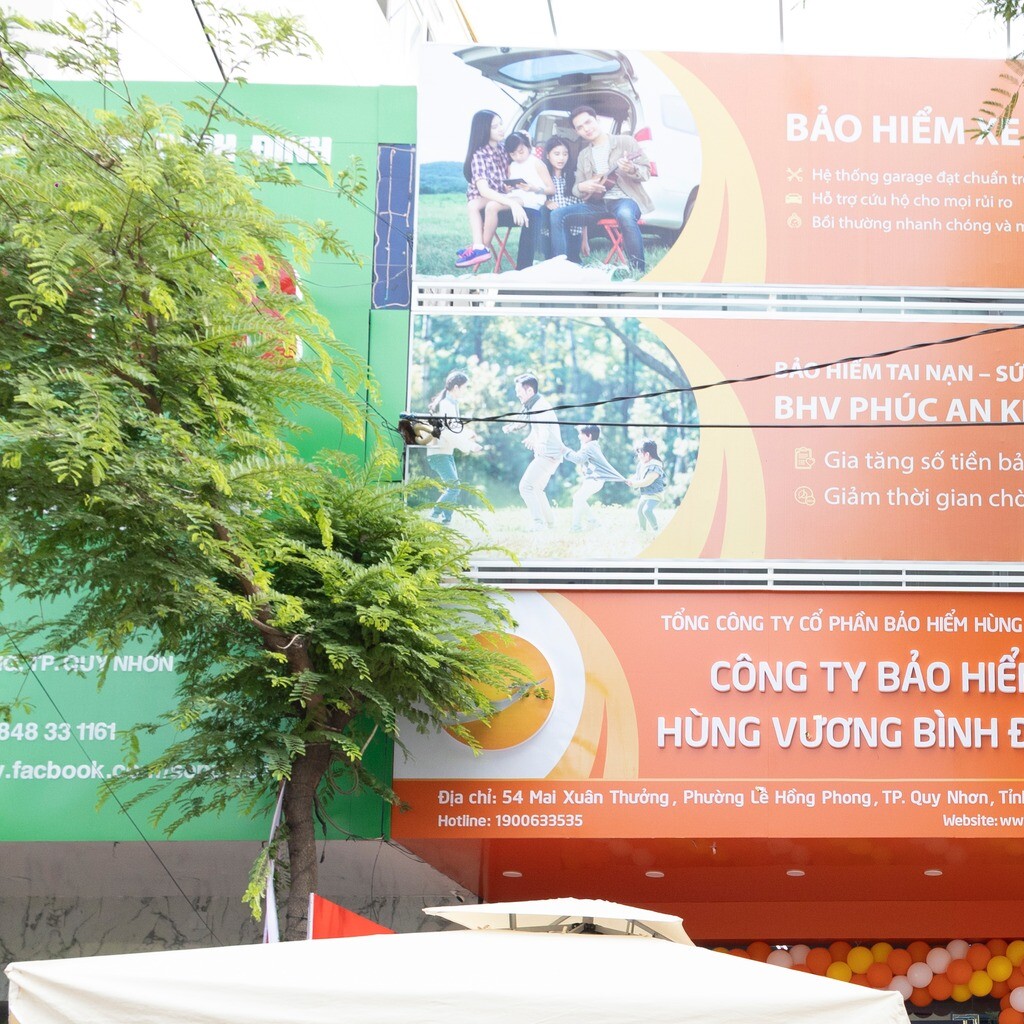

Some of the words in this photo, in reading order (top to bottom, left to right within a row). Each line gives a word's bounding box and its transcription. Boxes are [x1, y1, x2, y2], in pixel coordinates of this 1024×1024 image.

[786, 105, 862, 142] BẢO
[872, 106, 965, 145] HIỂM
[974, 117, 1020, 147] XE
[812, 168, 832, 184] Hệ
[835, 167, 879, 185] thống
[883, 172, 933, 186] garage
[936, 170, 960, 186] đạt
[963, 169, 1007, 185] chuẩn
[812, 189, 833, 206] Hỗ
[836, 194, 857, 208] trợ
[860, 191, 887, 207] cứu
[890, 192, 910, 209] hộ
[913, 194, 940, 207] cho
[944, 195, 971, 210] mọi
[975, 194, 994, 209] rủi
[998, 198, 1013, 208] ro
[811, 214, 835, 229] Bồi
[838, 215, 892, 232] thường
[896, 216, 942, 232] nhanh
[946, 218, 992, 234] chóng
[995, 219, 1012, 233] và
[775, 357, 820, 380] BẢO
[886, 363, 921, 381] TAI
[926, 363, 973, 387] NẠN
[774, 395, 842, 421] BHV
[850, 392, 938, 422] PHÚC
[945, 398, 990, 422] AN
[824, 451, 858, 470] Gia
[865, 451, 915, 475] tăng
[921, 450, 945, 471] số
[950, 450, 991, 471] tiền
[824, 486, 881, 506] Giảm
[886, 486, 930, 507] thời
[936, 489, 982, 512] gian
[661, 608, 709, 632] TỔNG
[717, 611, 763, 632] CÔNG
[770, 615, 793, 632] TY
[799, 608, 822, 632] CỔ
[828, 609, 878, 632] PHẦN
[884, 609, 920, 633] BẢO
[926, 610, 968, 633] HIỂM
[974, 612, 1023, 634] HÙNG
[31, 655, 58, 672] TP.
[64, 655, 107, 672] QUY
[113, 653, 174, 672] NHƠN
[710, 652, 807, 694] CÔNG
[819, 660, 866, 694] TY
[877, 649, 951, 695] BẢO
[44, 722, 71, 742] 33
[76, 722, 117, 741] 1161
[657, 707, 761, 749] HÙNG
[772, 713, 902, 750] VƯƠNG
[913, 709, 998, 750] BÌNH
[437, 789, 463, 808] Địa
[468, 788, 497, 805] chỉ:
[502, 790, 523, 805] 54
[529, 790, 557, 805] Mai
[562, 789, 603, 805] Xuân
[683, 788, 744, 808] Phường
[775, 788, 815, 807] Hồng
[882, 790, 906, 805] TP.
[910, 790, 941, 808] Quy
[437, 814, 491, 828] Hotline:
[495, 814, 584, 828] 1900633535
[943, 814, 998, 828] Website:
